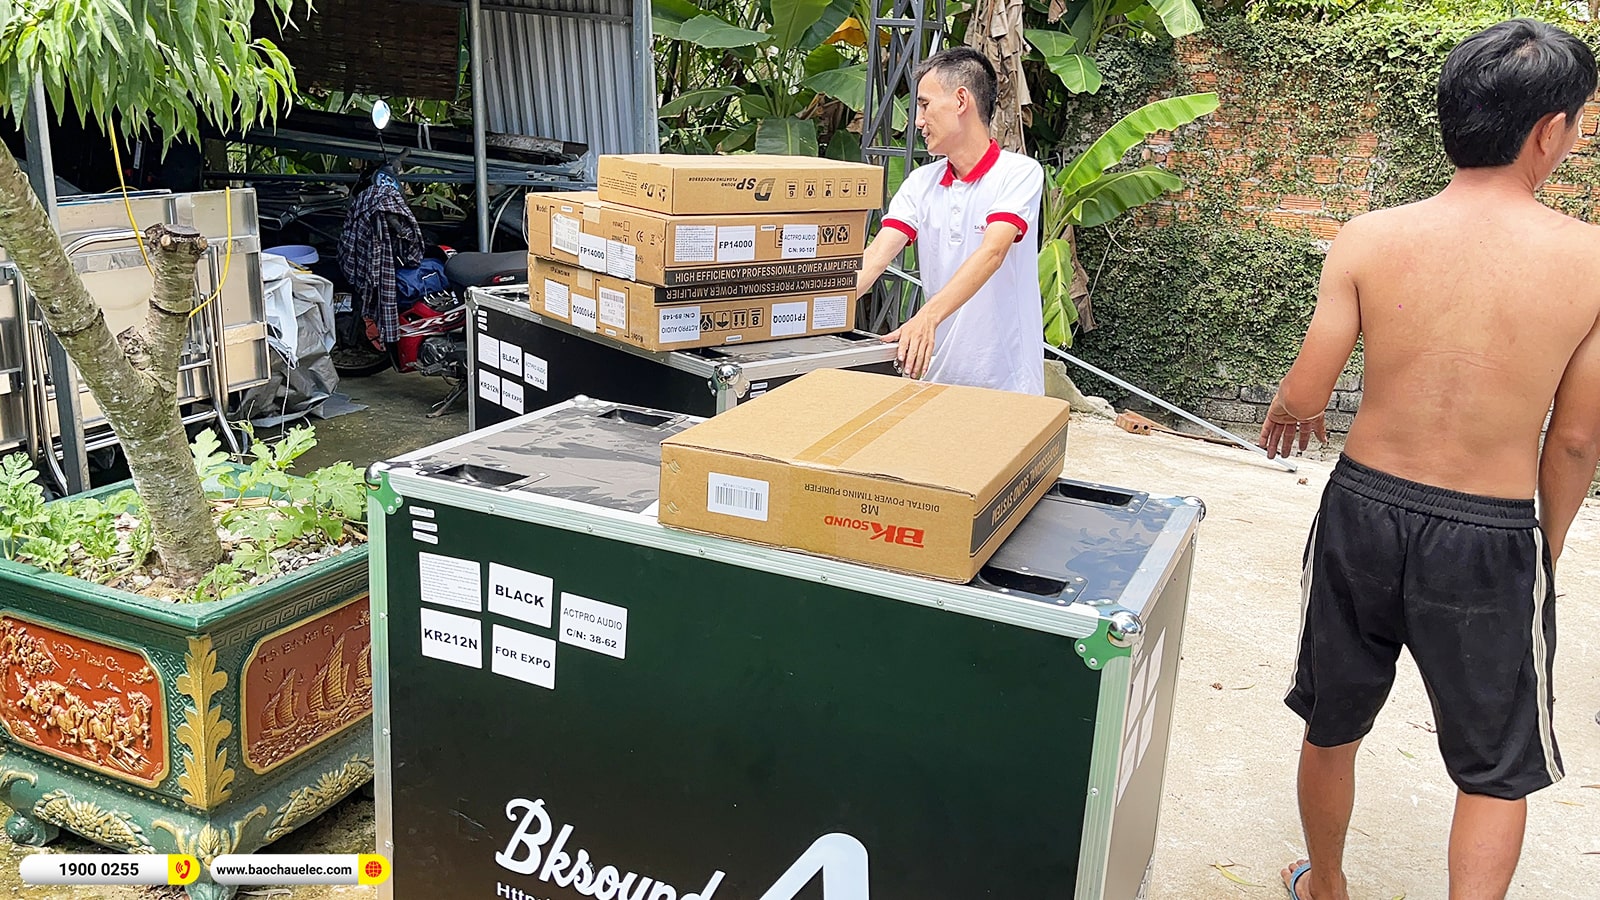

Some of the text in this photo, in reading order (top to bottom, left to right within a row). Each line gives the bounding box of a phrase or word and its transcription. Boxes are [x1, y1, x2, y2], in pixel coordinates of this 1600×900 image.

[718, 240, 753, 250] FP14000
[784, 233, 816, 242] ACTPRO AUDIO
[580, 246, 605, 260] FP14000
[675, 260, 858, 282] HIGH EFFICIENCY PROFESSIONAL POWER AMPLIFIER
[666, 277, 854, 300] HIGH EFFICIENCY PROFESSIONAL POWER AMPLIFIER
[661, 325, 699, 334] ACTPRO AUDIO
[773, 313, 806, 324] FP10000Q
[502, 353, 520, 365] BLACK
[804, 483, 940, 513] DIGITAL POWER TIMING PURIFIER
[1012, 474, 1030, 502] SOUND
[861, 503, 880, 516] M8
[991, 491, 1013, 527] SYSTEM
[823, 515, 870, 531] SOUND
[495, 584, 545, 608] BLACK
[563, 607, 623, 631] ACTPRO AUDIO
[424, 628, 478, 650] KR212N
[566, 627, 617, 649] C/N: 38-62
[495, 646, 551, 669] FOR EXPO
